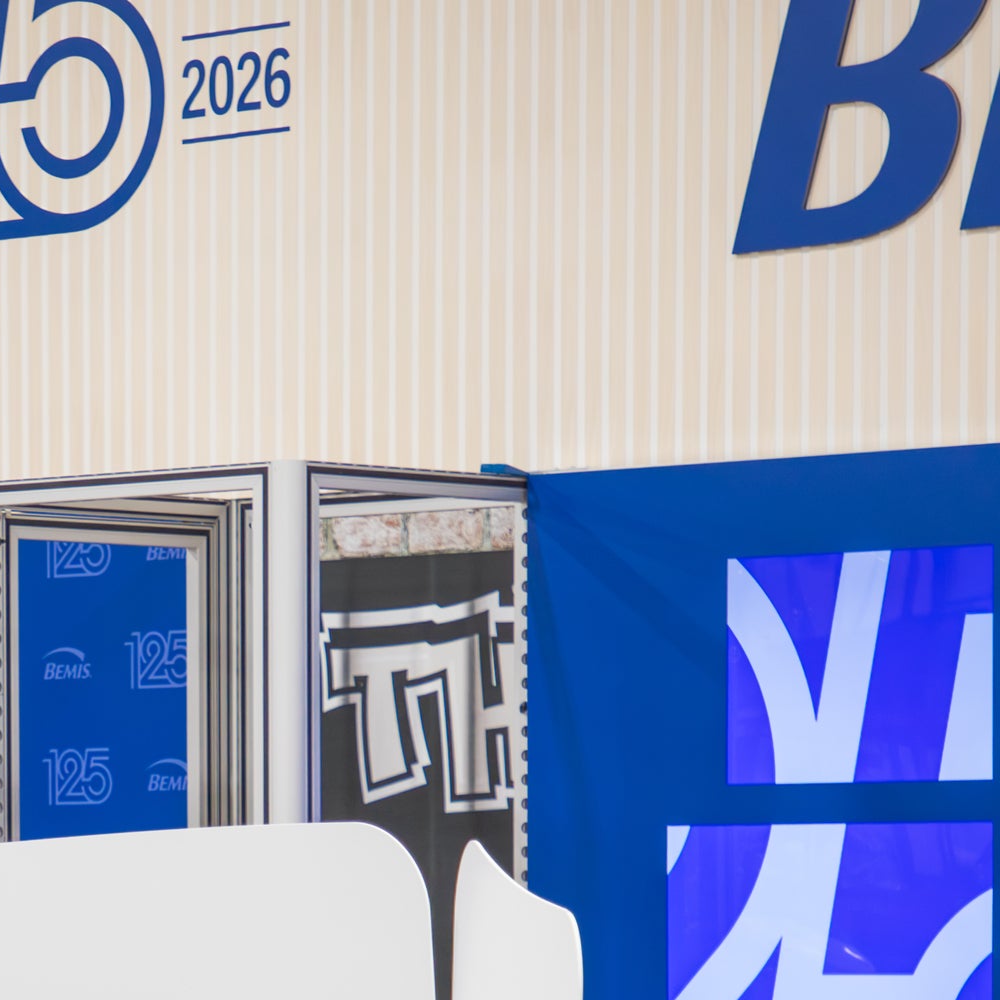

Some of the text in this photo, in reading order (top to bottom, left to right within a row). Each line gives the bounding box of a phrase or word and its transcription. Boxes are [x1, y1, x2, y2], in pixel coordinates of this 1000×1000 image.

[181, 47, 291, 120] 2026
[731, 0, 1000, 256] B
[146, 546, 186, 561] BEMI
[43, 662, 91, 680] BEMIS
[124, 629, 186, 690] 125
[42, 747, 113, 806] 125
[147, 773, 187, 792] BEMI
